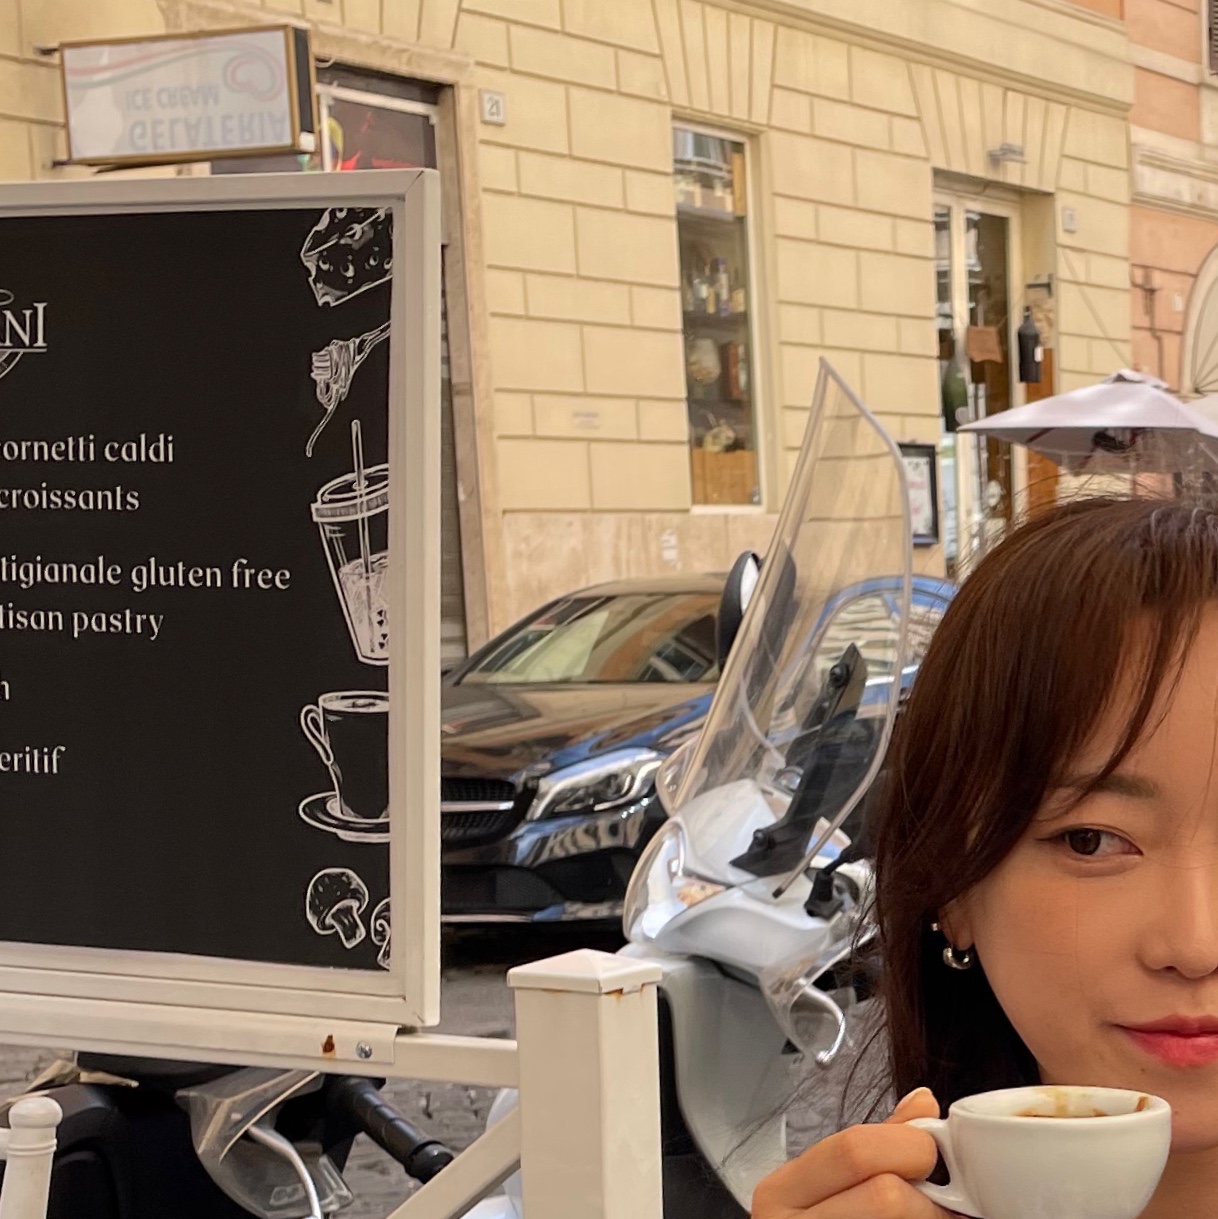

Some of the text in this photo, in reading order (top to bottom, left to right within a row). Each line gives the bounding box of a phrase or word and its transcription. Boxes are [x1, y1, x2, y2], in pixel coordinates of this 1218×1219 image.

[0, 433, 174, 463] ornetti caldi
[0, 555, 291, 592] tigianale gluten free
[72, 605, 164, 641] pastry
